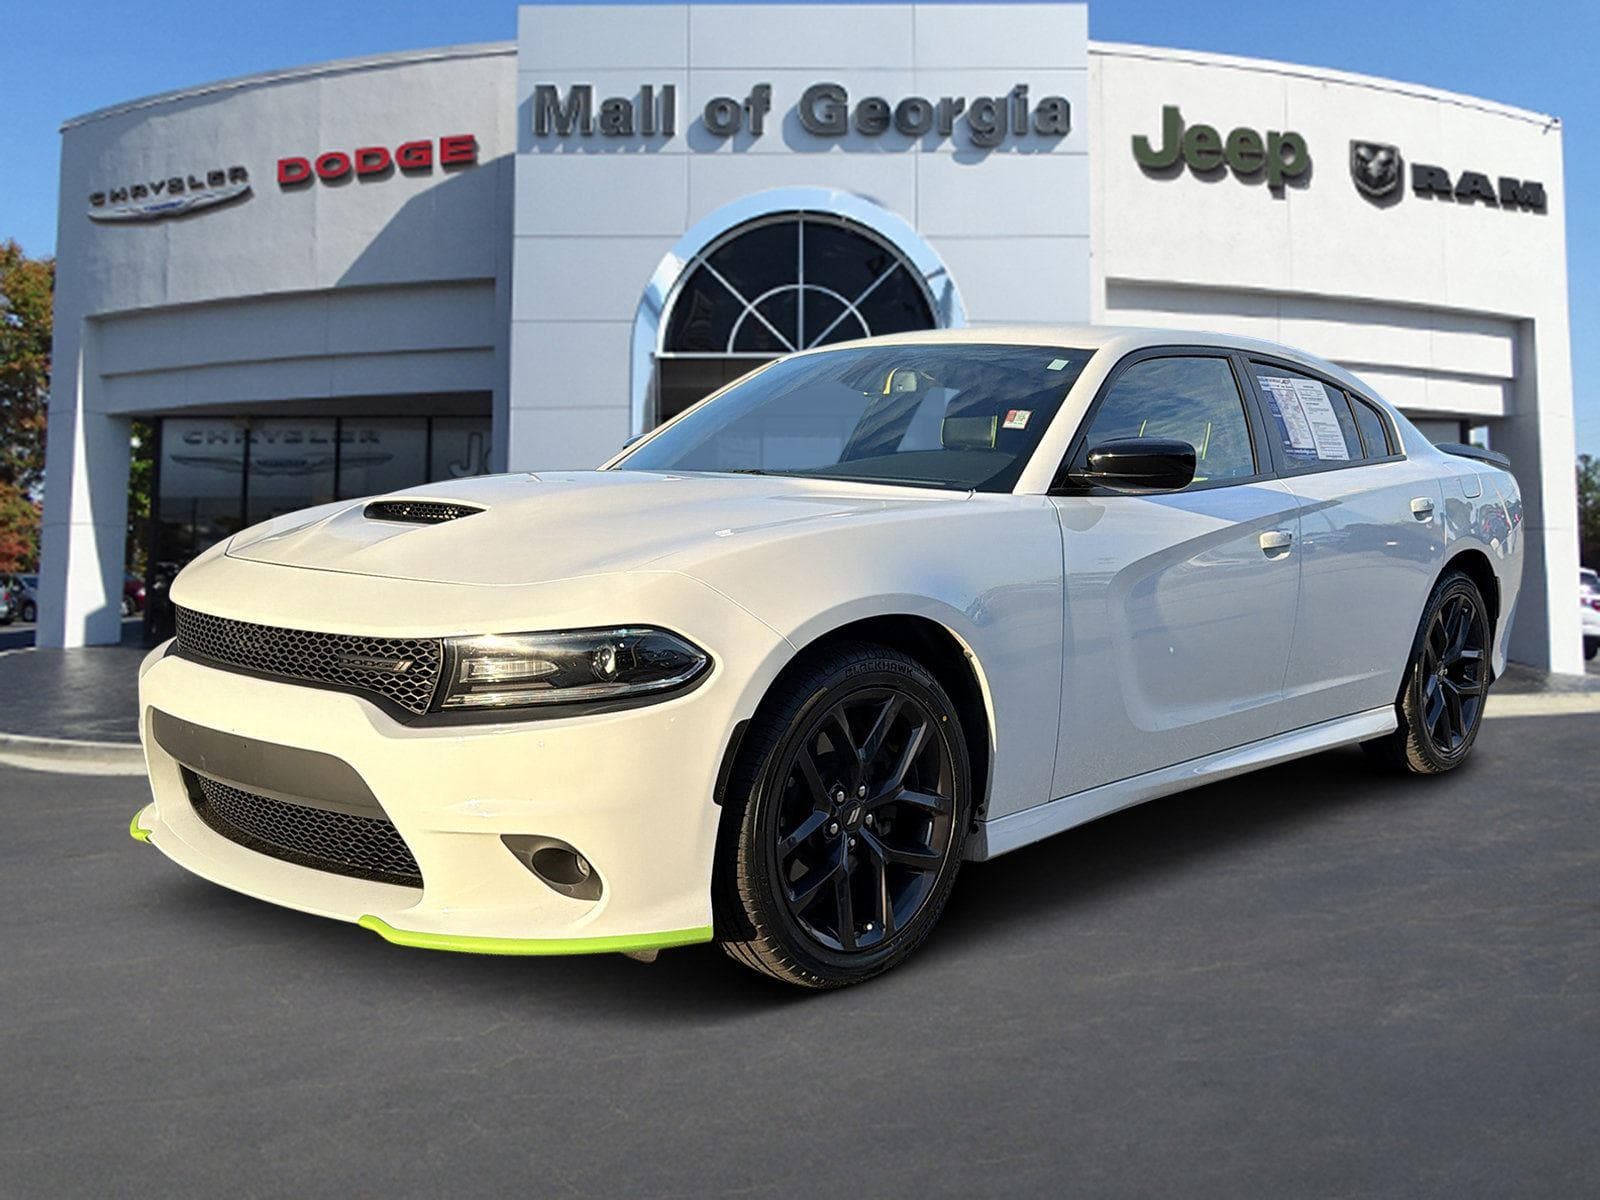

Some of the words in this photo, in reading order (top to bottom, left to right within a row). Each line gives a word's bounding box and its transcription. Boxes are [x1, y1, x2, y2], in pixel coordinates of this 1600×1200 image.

[532, 84, 676, 137] Mall
[702, 83, 772, 136] of
[798, 83, 1072, 148] Georgia
[277, 134, 478, 186] DODGE
[1131, 105, 1311, 190] Jeep
[89, 166, 248, 206] CHRYSLER
[1410, 163, 1547, 211] RAM
